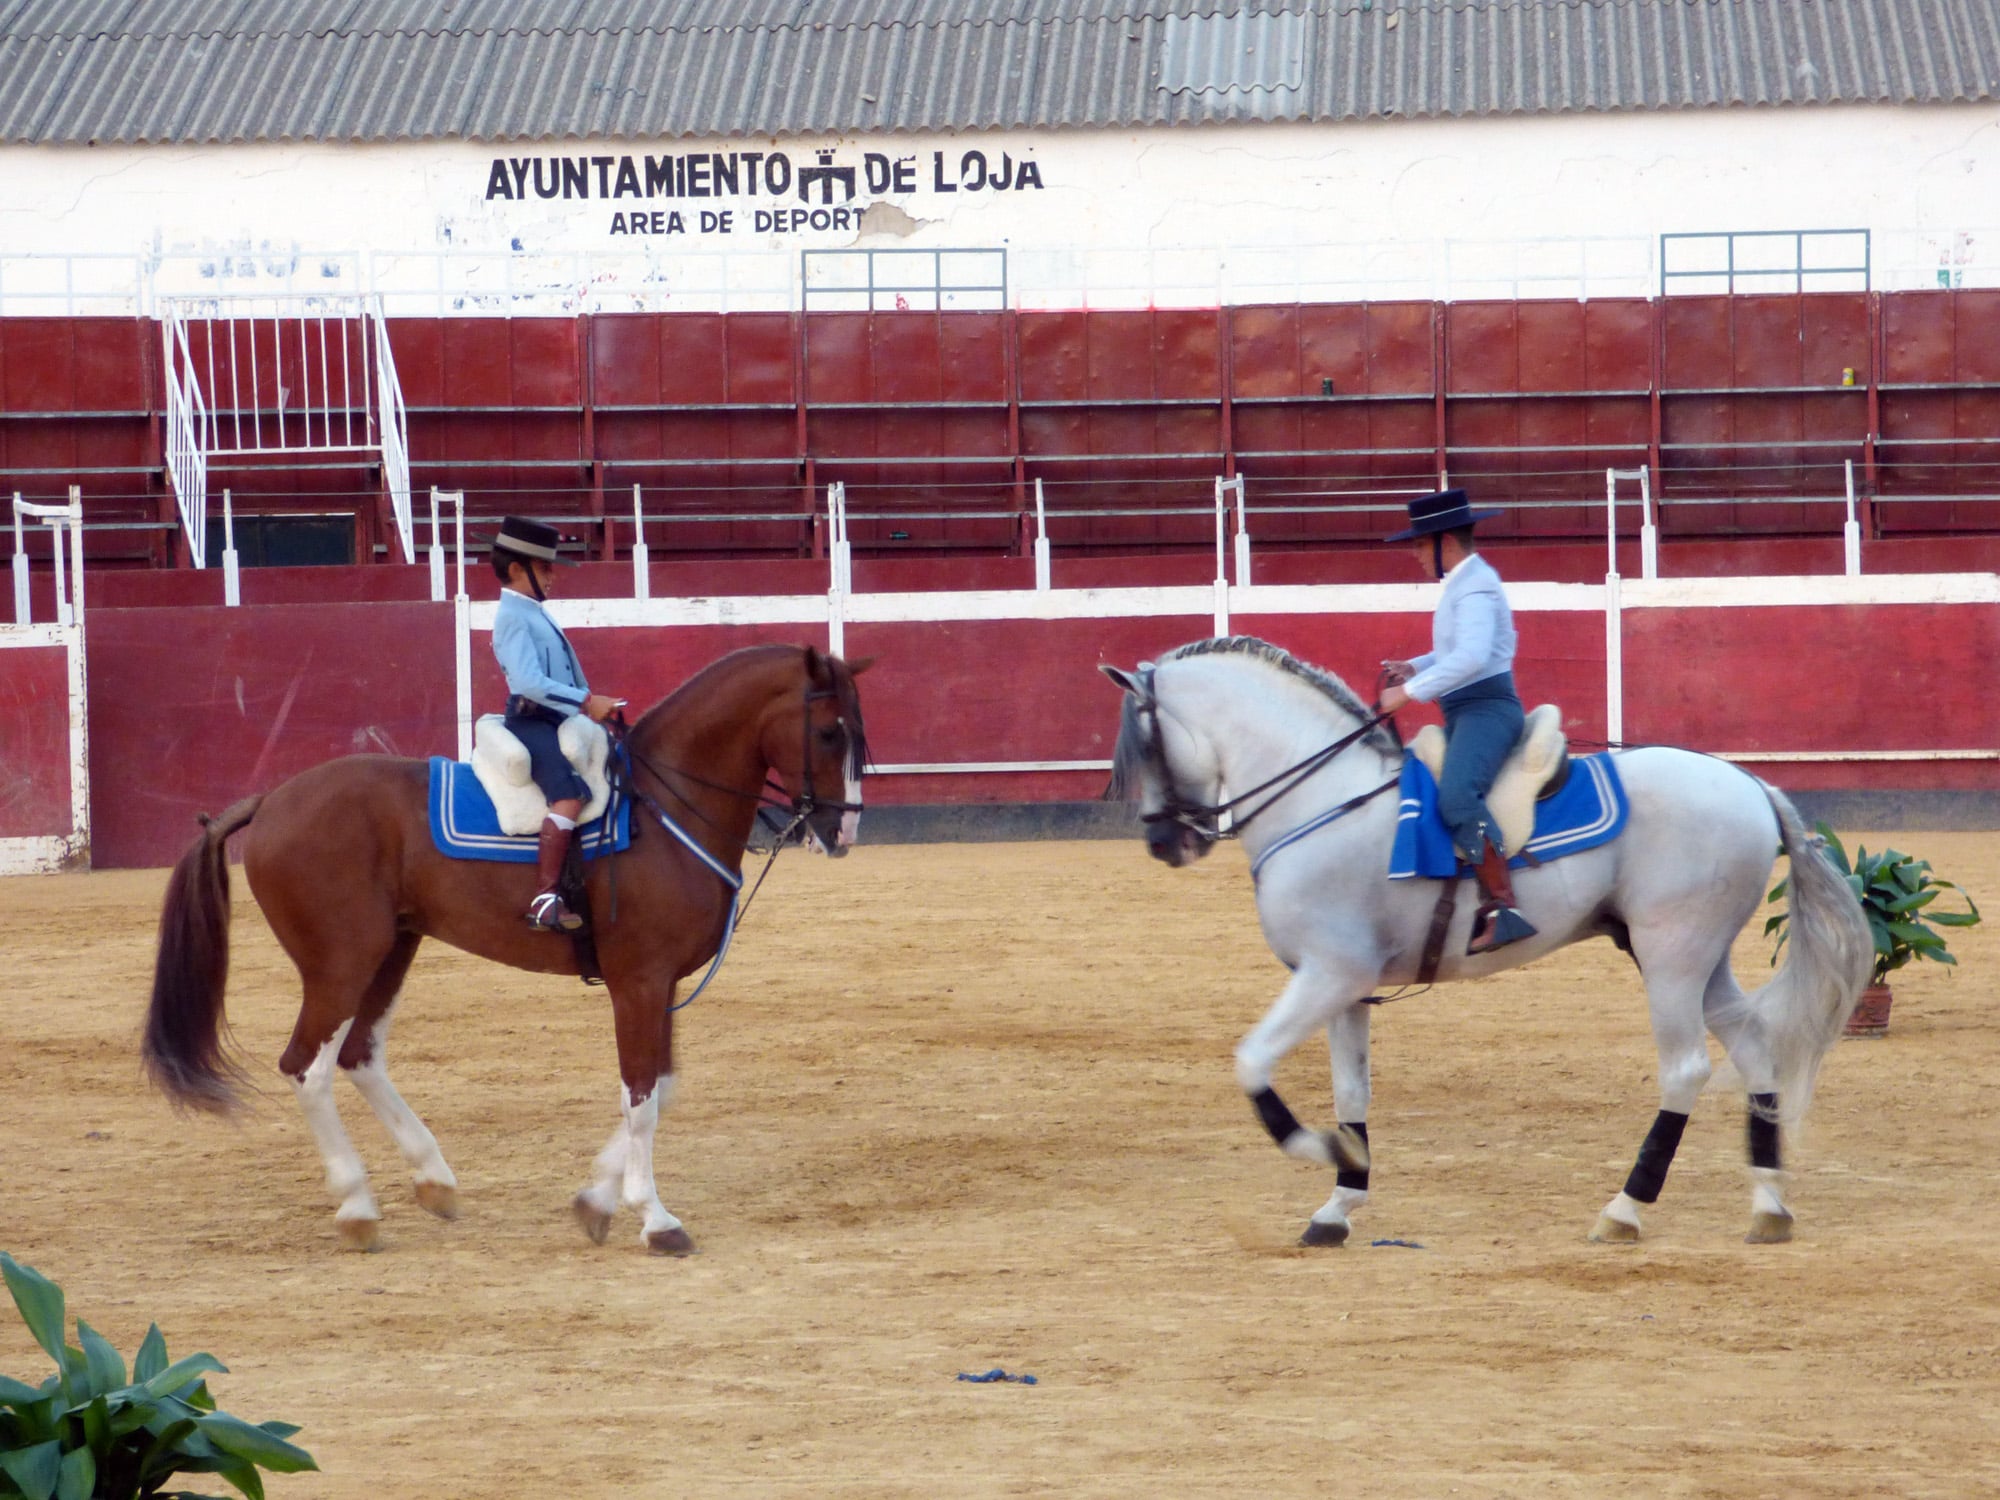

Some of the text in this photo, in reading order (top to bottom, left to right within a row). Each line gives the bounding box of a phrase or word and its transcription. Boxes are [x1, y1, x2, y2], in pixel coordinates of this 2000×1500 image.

[485, 149, 1044, 200] AYUNTAMIENTO DE LOJA
[609, 211, 686, 235] AREA
[700, 210, 733, 234] DE
